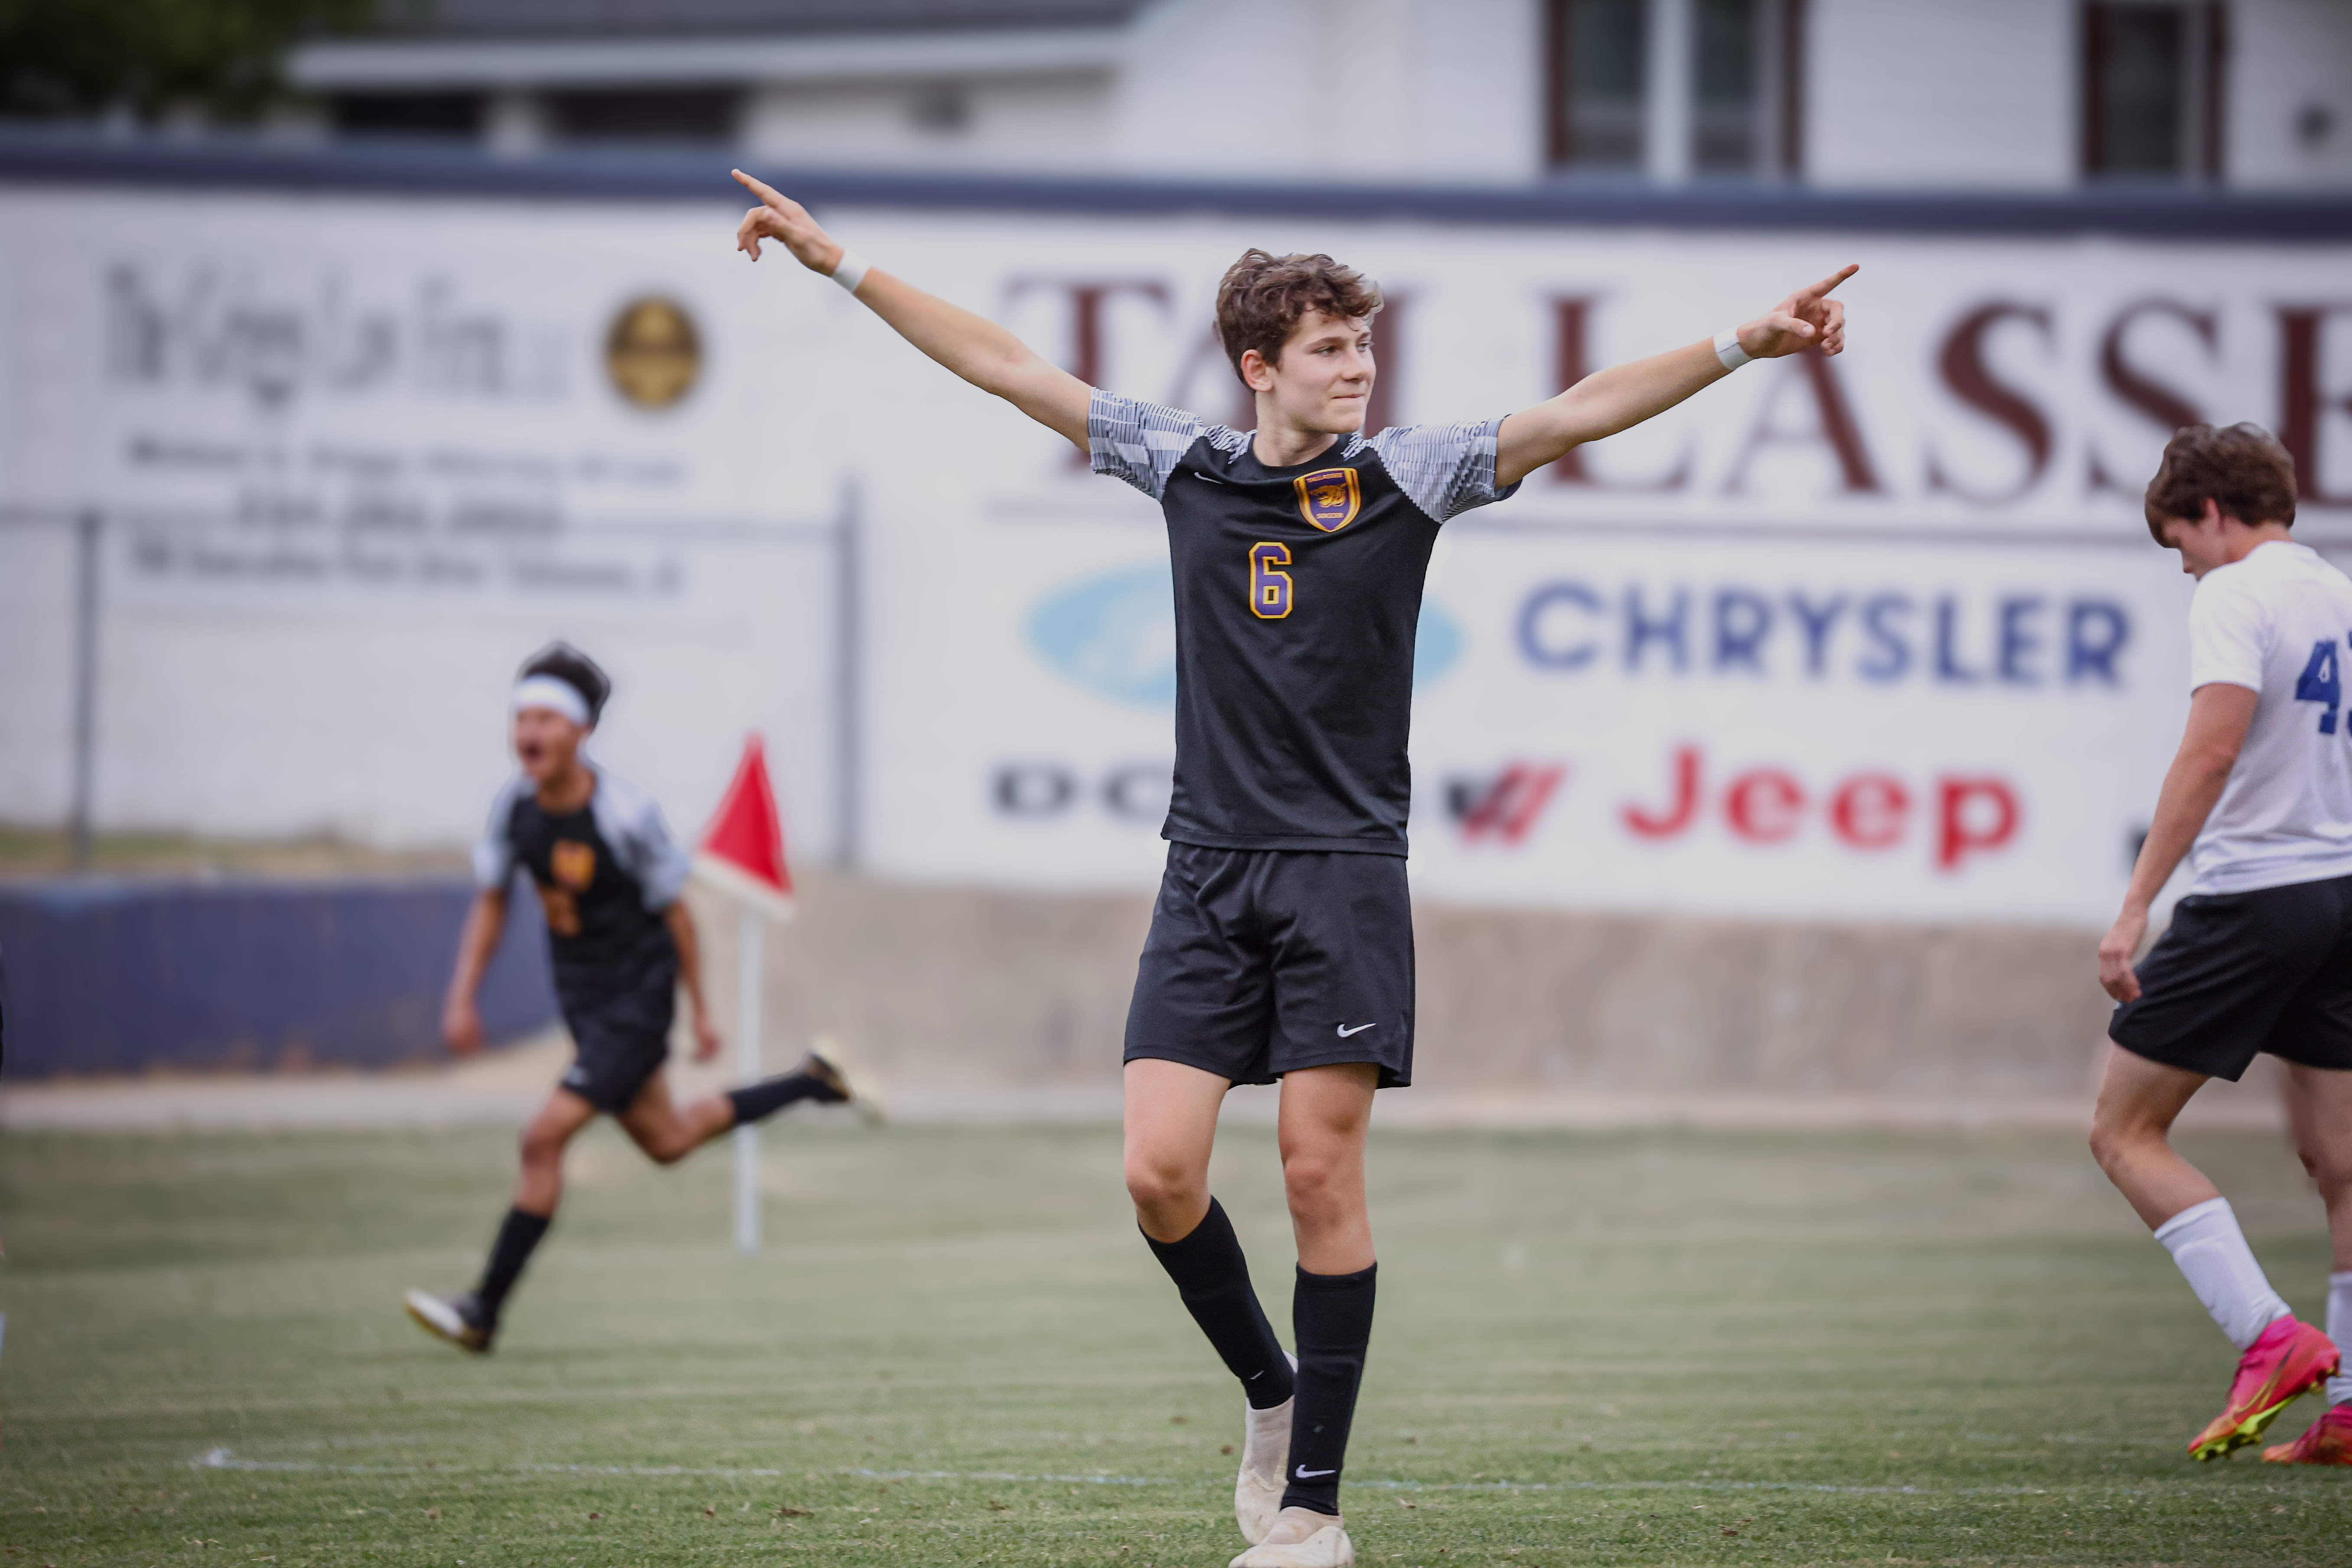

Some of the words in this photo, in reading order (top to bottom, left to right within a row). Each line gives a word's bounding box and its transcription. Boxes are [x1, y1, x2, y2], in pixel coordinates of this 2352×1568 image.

[1249, 542, 1293, 619] 6
[1516, 581, 2131, 687] CHRYSLER
[2295, 631, 2352, 738] 4
[1619, 745, 2021, 873] Jeep
